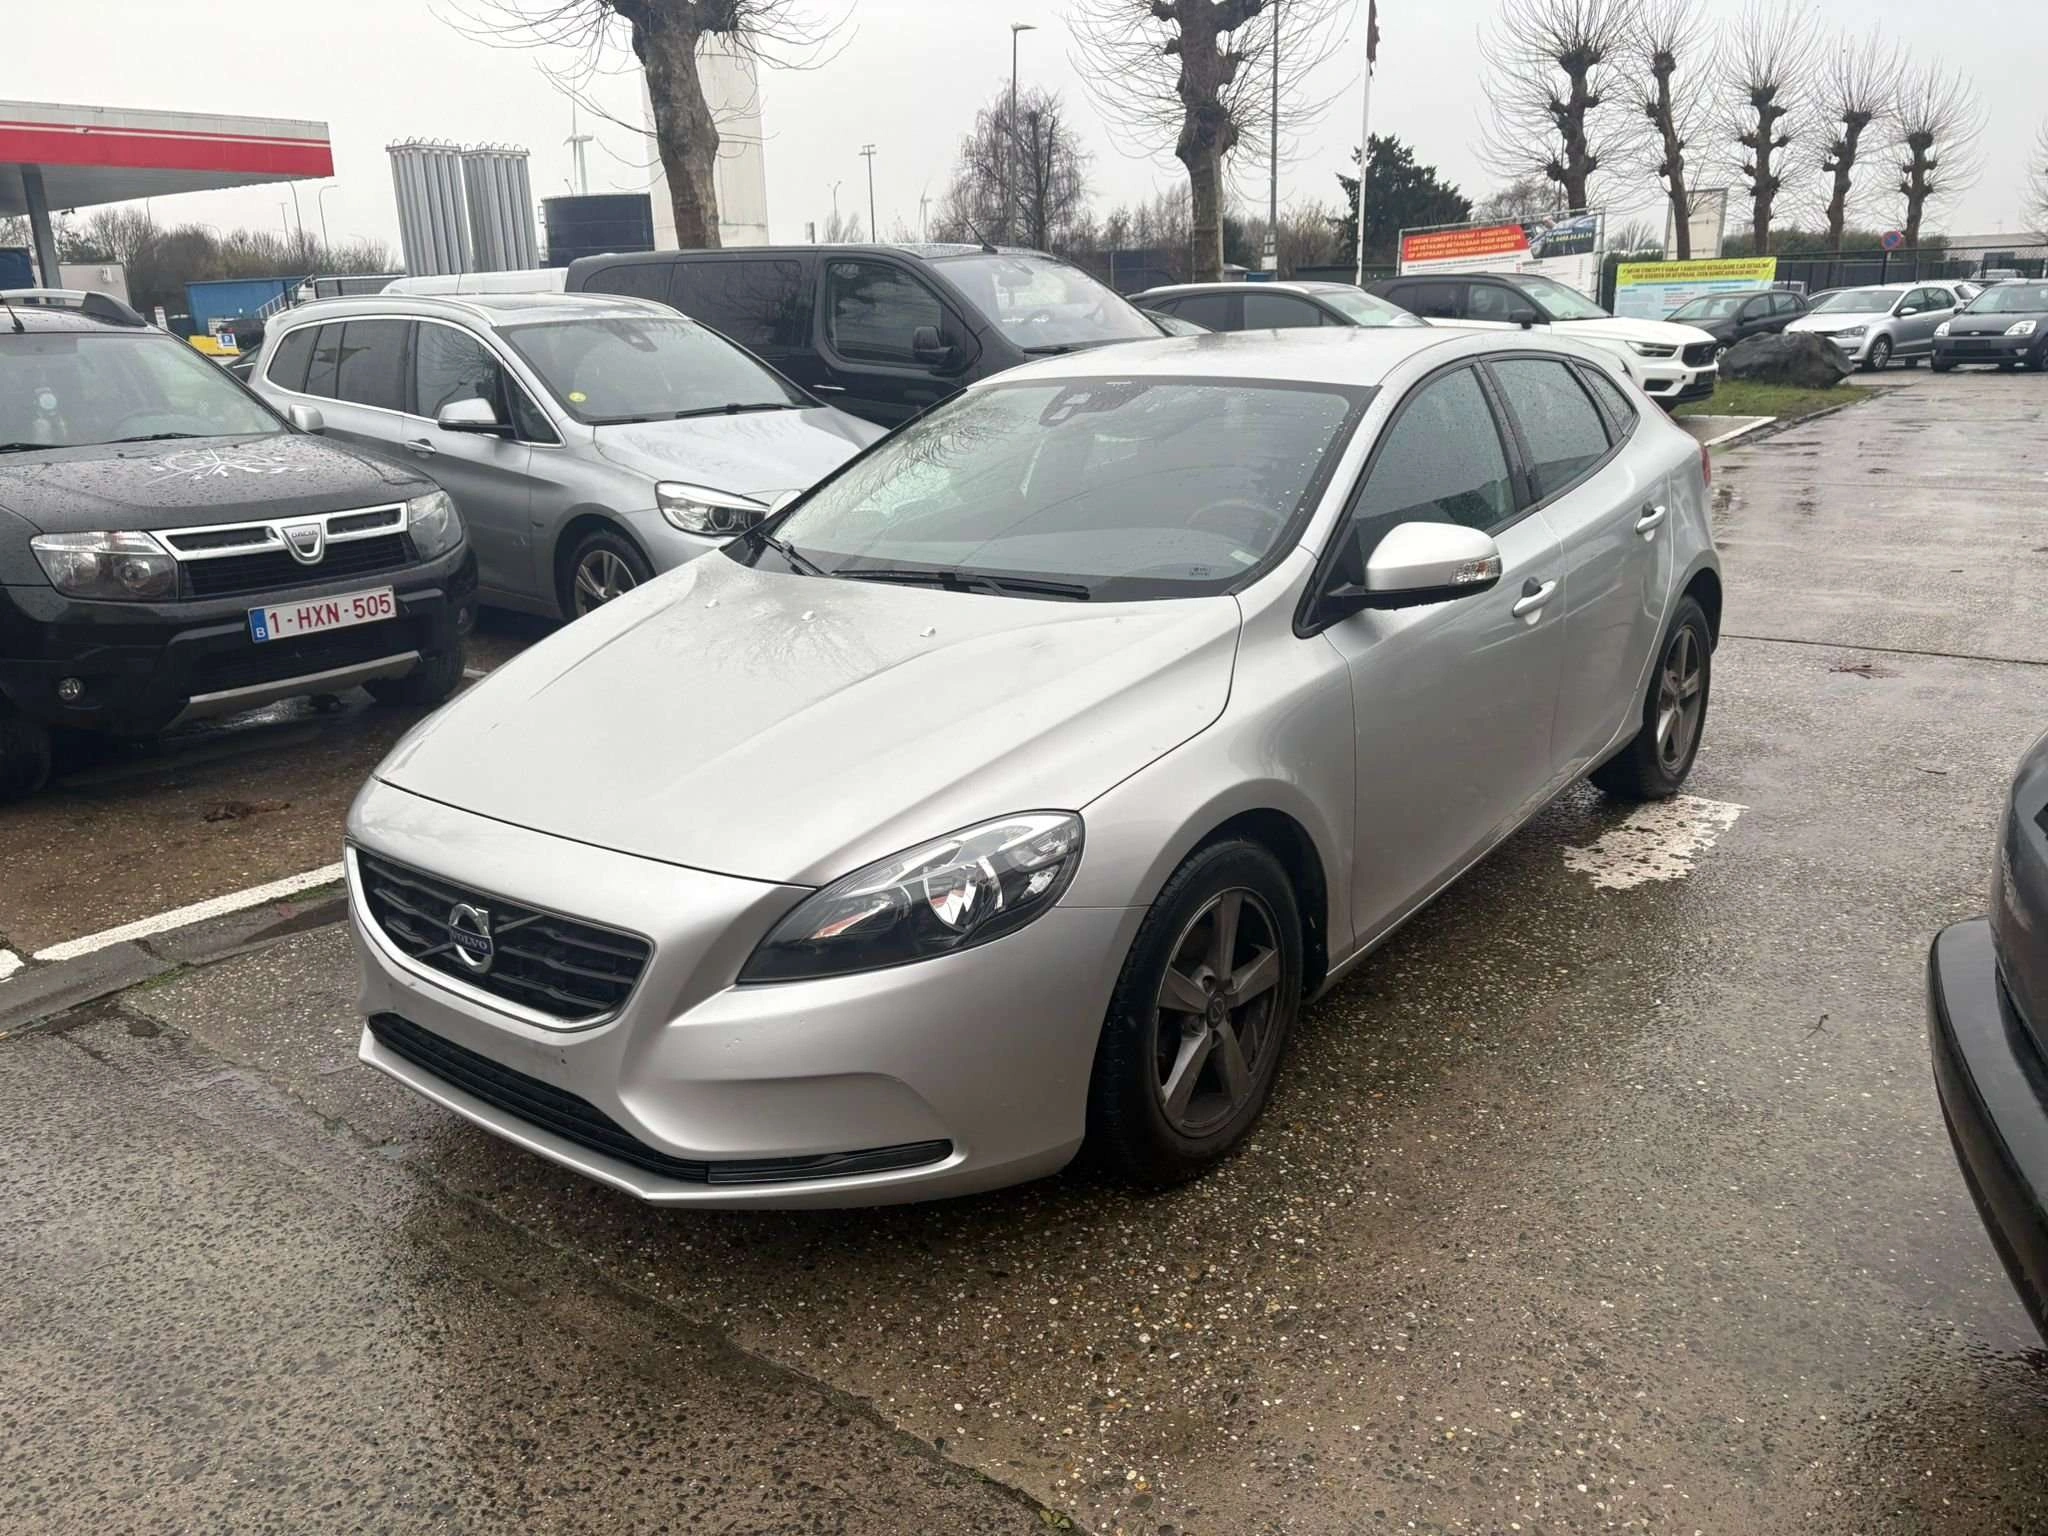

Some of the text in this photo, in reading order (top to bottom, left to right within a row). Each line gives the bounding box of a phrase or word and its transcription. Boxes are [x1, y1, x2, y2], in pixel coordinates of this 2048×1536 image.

[269, 593, 392, 634] 1-HXN-505
[256, 627, 267, 639] B
[452, 930, 488, 950] VOLVO
